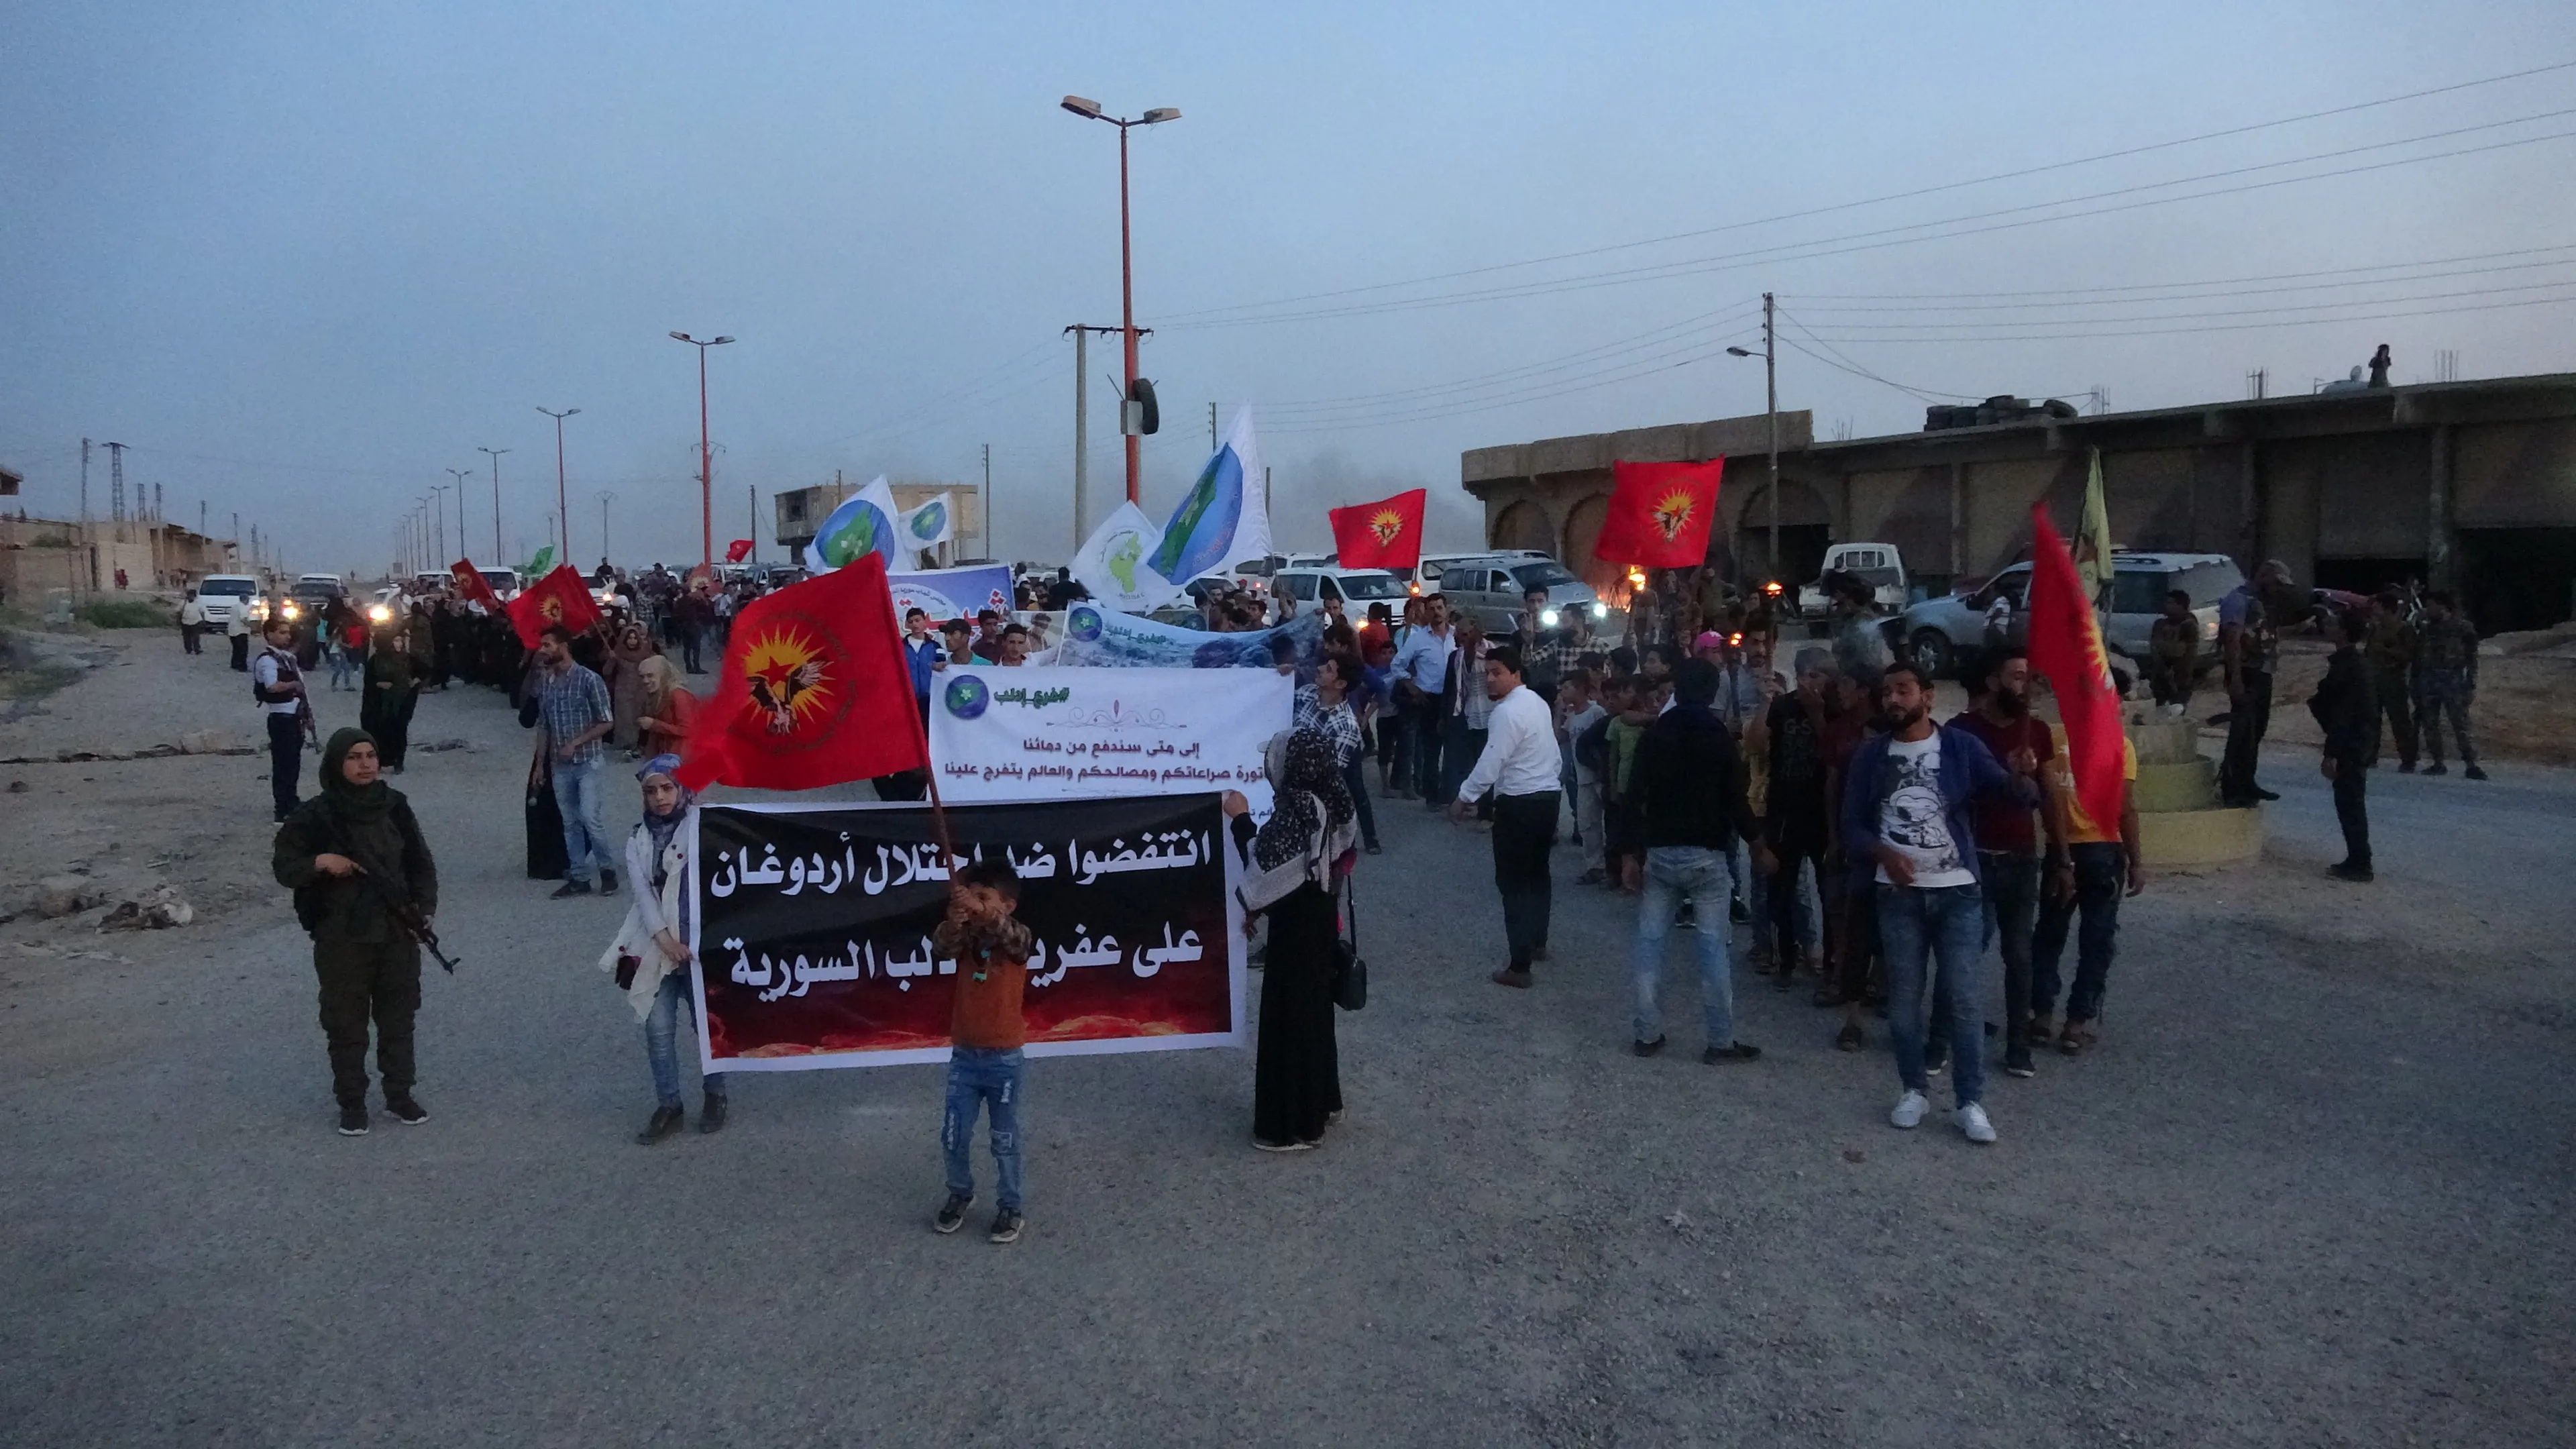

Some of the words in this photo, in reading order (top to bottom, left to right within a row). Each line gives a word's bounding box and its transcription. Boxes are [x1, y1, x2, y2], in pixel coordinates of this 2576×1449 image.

[1023, 737, 1062, 752] دمائنا
[1066, 741, 1087, 755] من
[1091, 739, 1142, 758] سندفع
[1146, 740, 1175, 757] متى
[1179, 741, 1199, 759] إلى
[944, 761, 979, 779] علينا
[983, 762, 1024, 782] يتفرج
[1027, 764, 1073, 782] والعالم
[1077, 765, 1157, 784] ومصالحكم
[1161, 765, 1231, 784] صراعاتكم
[1236, 764, 1264, 784] تورة
[710, 832, 855, 898] أردوغان
[1069, 828, 1211, 885] انتفضوا
[1026, 923, 1122, 988] عفري
[1132, 920, 1203, 978] على
[722, 936, 875, 1002] السورية
